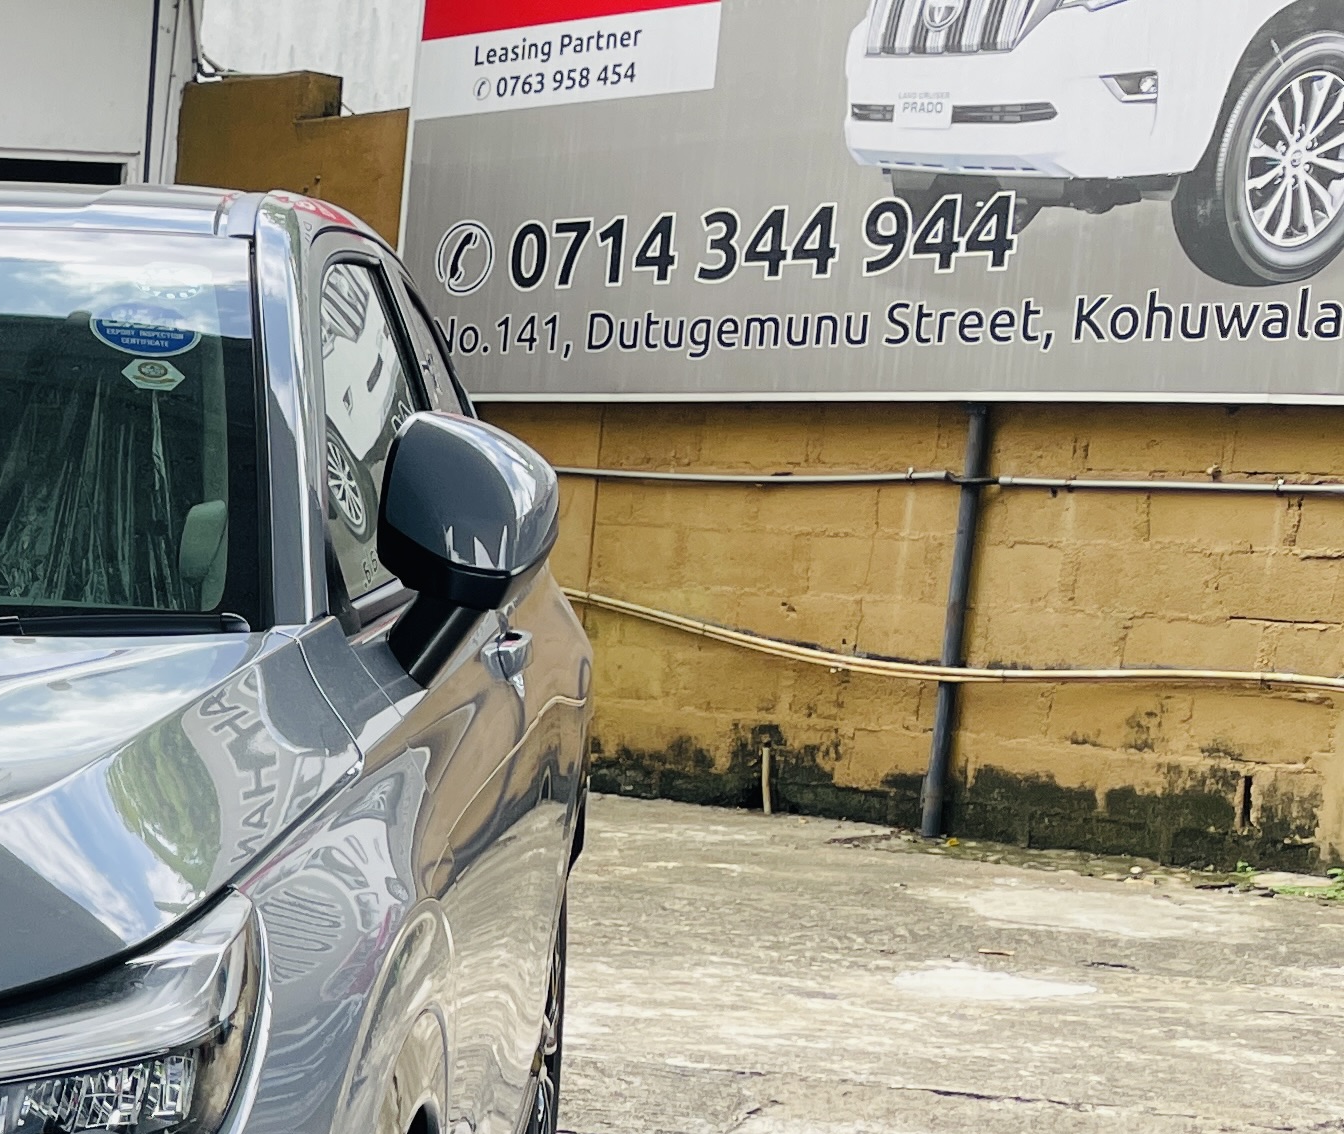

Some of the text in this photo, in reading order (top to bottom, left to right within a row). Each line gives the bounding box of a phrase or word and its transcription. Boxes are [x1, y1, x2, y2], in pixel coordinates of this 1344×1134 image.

[474, 29, 642, 66] Leasing Partner
[496, 62, 636, 98] 0763 958 454
[902, 102, 943, 113] PRADO
[510, 191, 1017, 290] 0714 344 944
[587, 310, 869, 358] Dutugemunu
[884, 298, 1053, 351] Street,
[1073, 287, 1343, 340] Kohuwala
